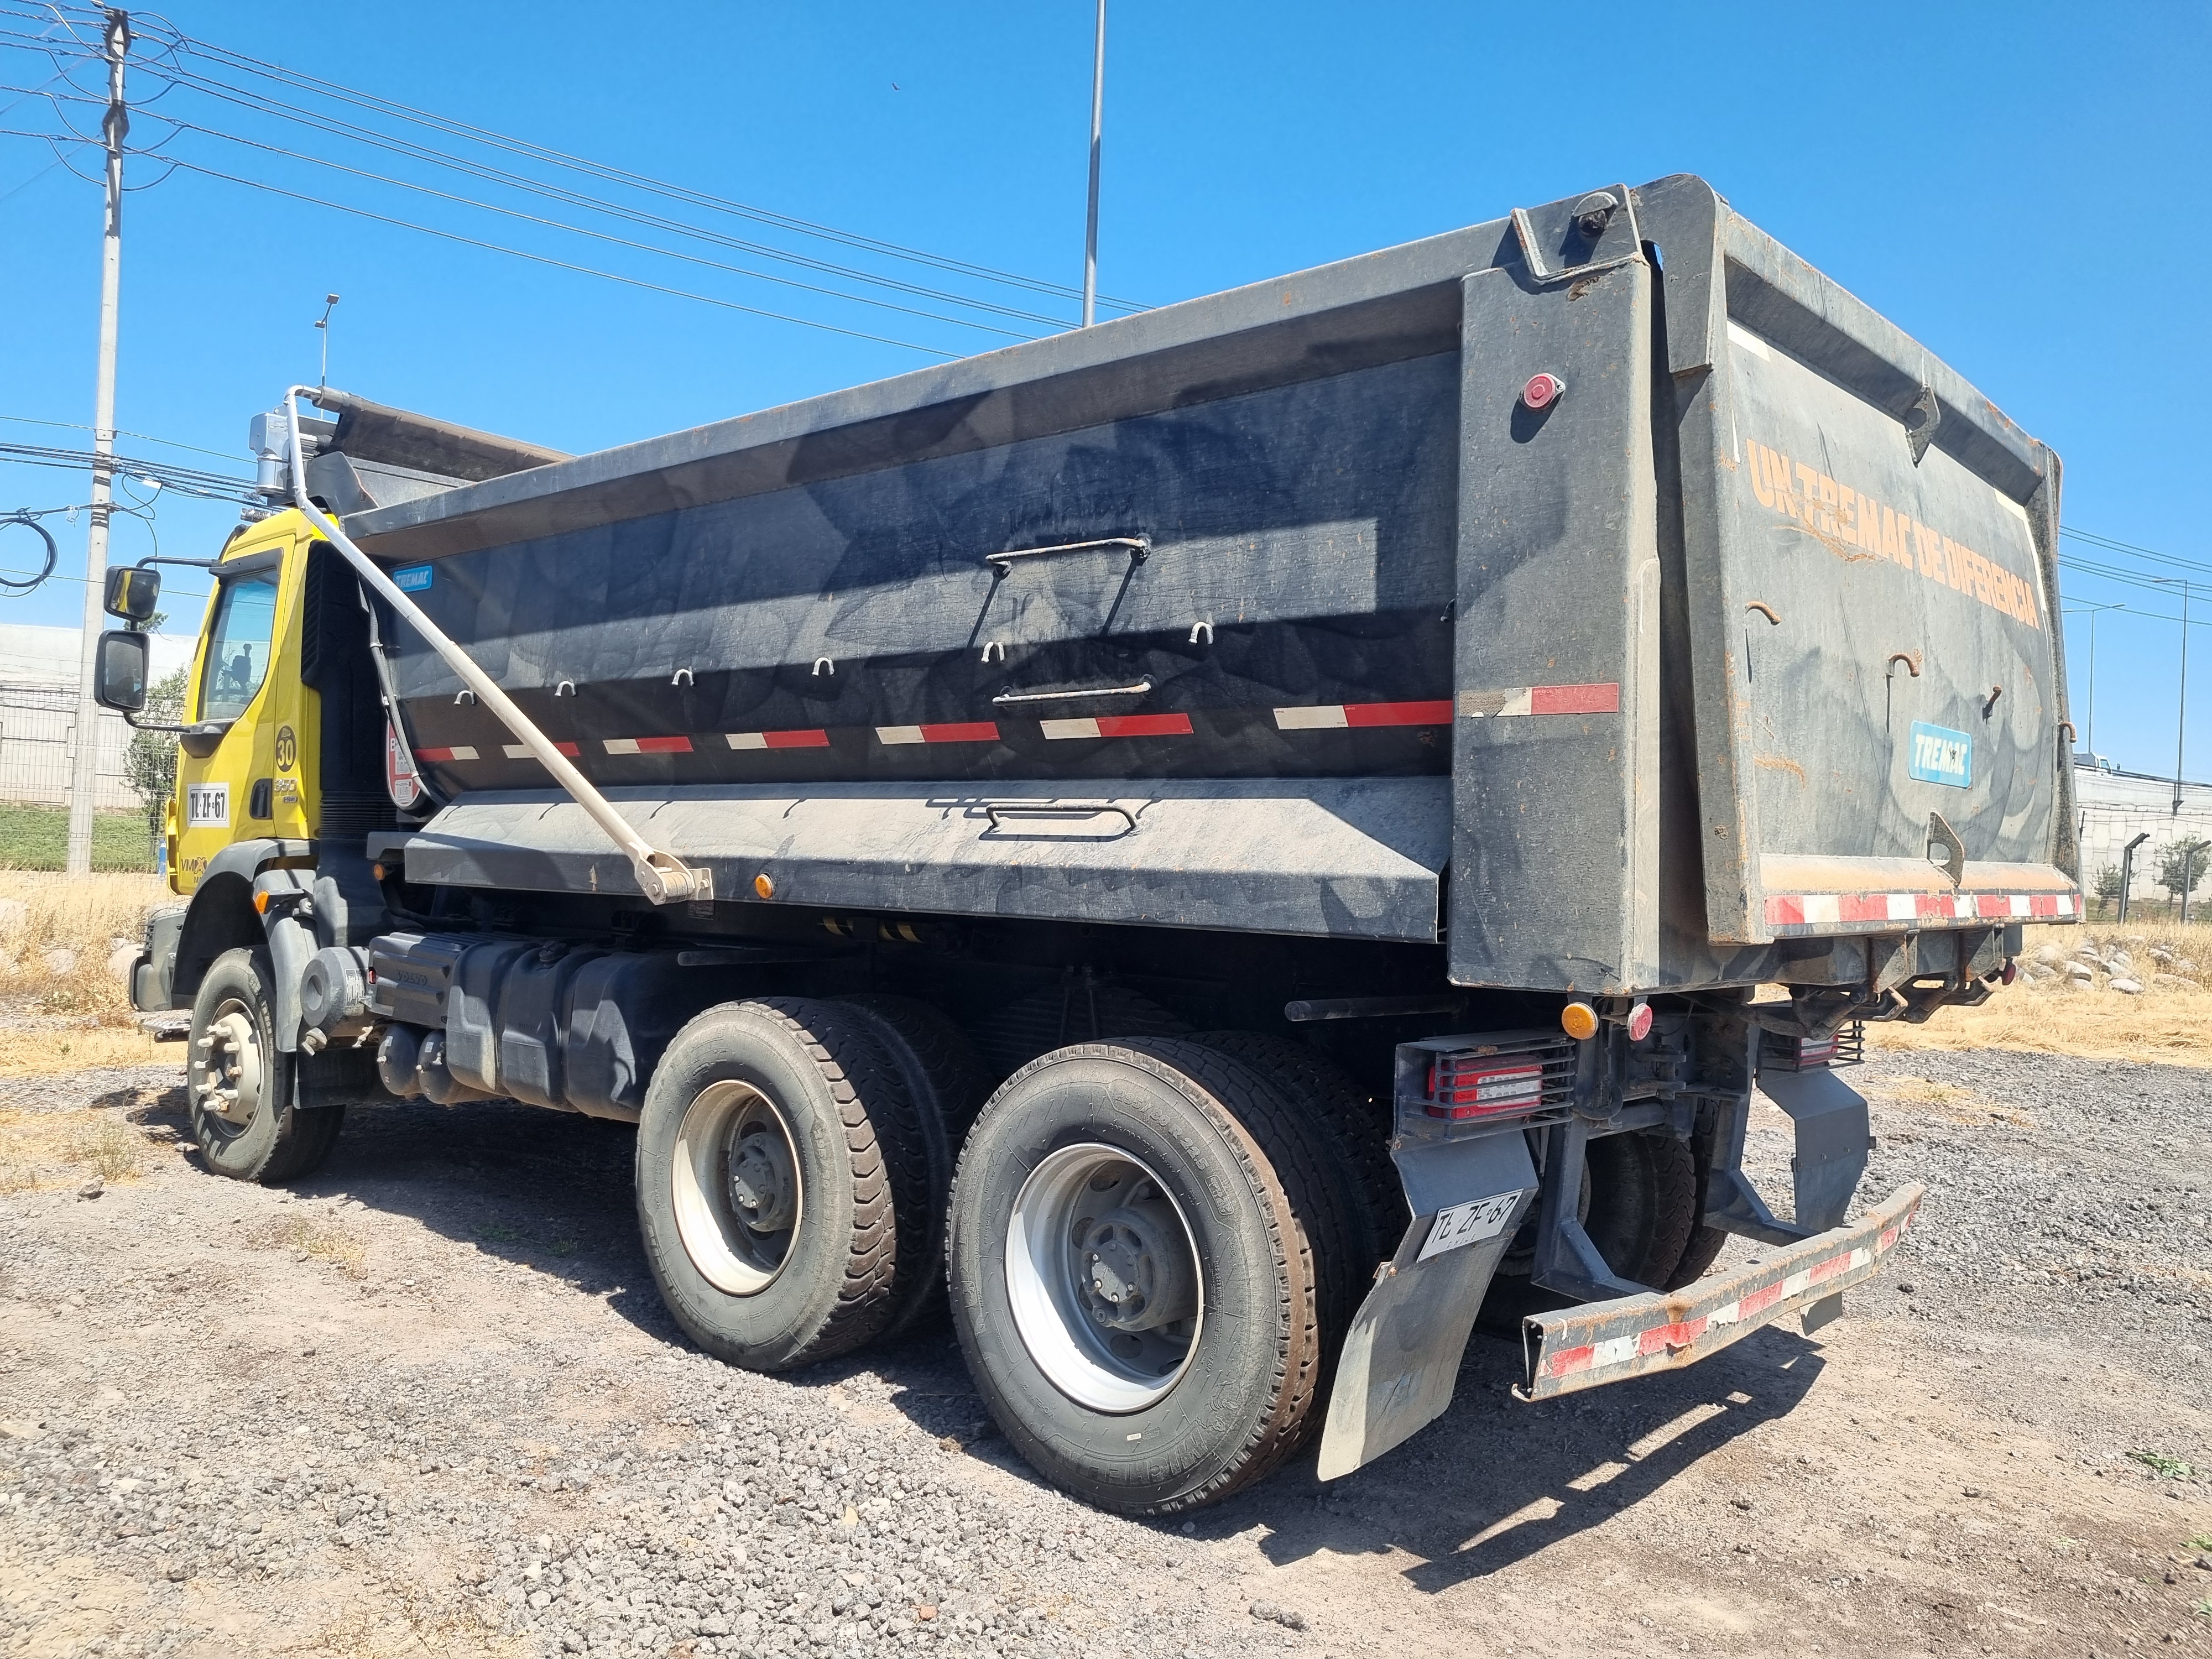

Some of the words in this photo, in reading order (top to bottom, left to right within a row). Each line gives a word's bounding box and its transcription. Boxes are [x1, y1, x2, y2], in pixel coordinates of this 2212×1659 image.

[1746, 439, 1797, 519] UN
[1796, 462, 1914, 571] TREMAC
[1913, 520, 1946, 585] DE
[1942, 536, 2040, 631] DIFERENCIA
[396, 570, 429, 588] TREMAC
[278, 739, 294, 766] 30
[1914, 733, 1968, 776] TREMAC
[274, 778, 298, 792] 350
[397, 970, 428, 987] VOLVO
